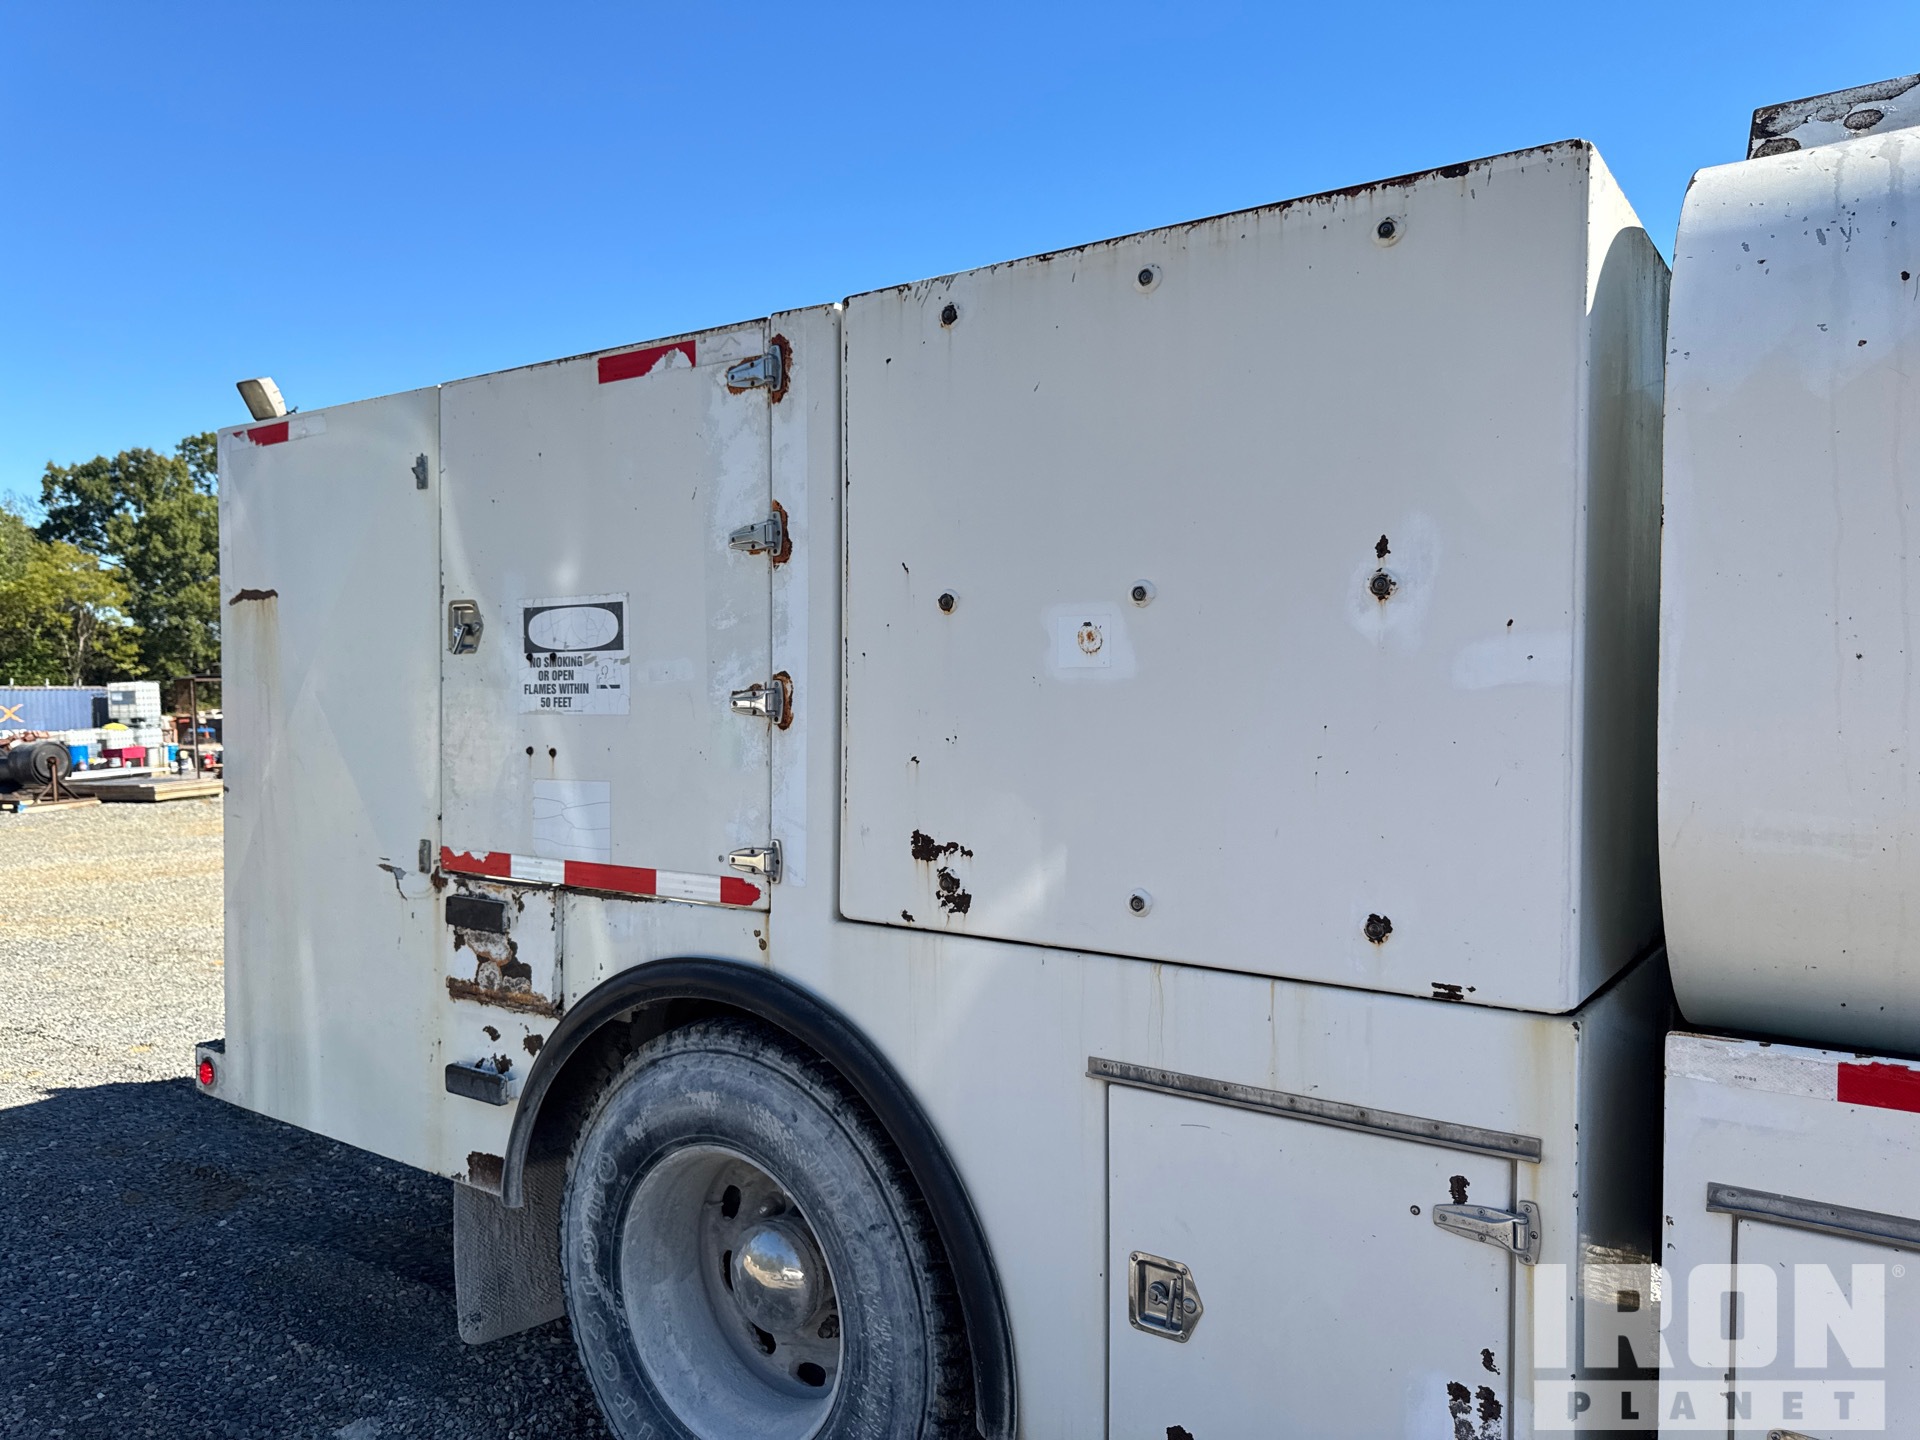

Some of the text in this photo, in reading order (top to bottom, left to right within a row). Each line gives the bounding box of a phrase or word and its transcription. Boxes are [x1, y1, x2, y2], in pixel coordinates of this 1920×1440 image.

[529, 656, 583, 668] NO SMOKING
[538, 670, 575, 681] OR OPEN
[524, 683, 590, 695] FLAMES WITHIN
[540, 697, 573, 708] 50 FEET
